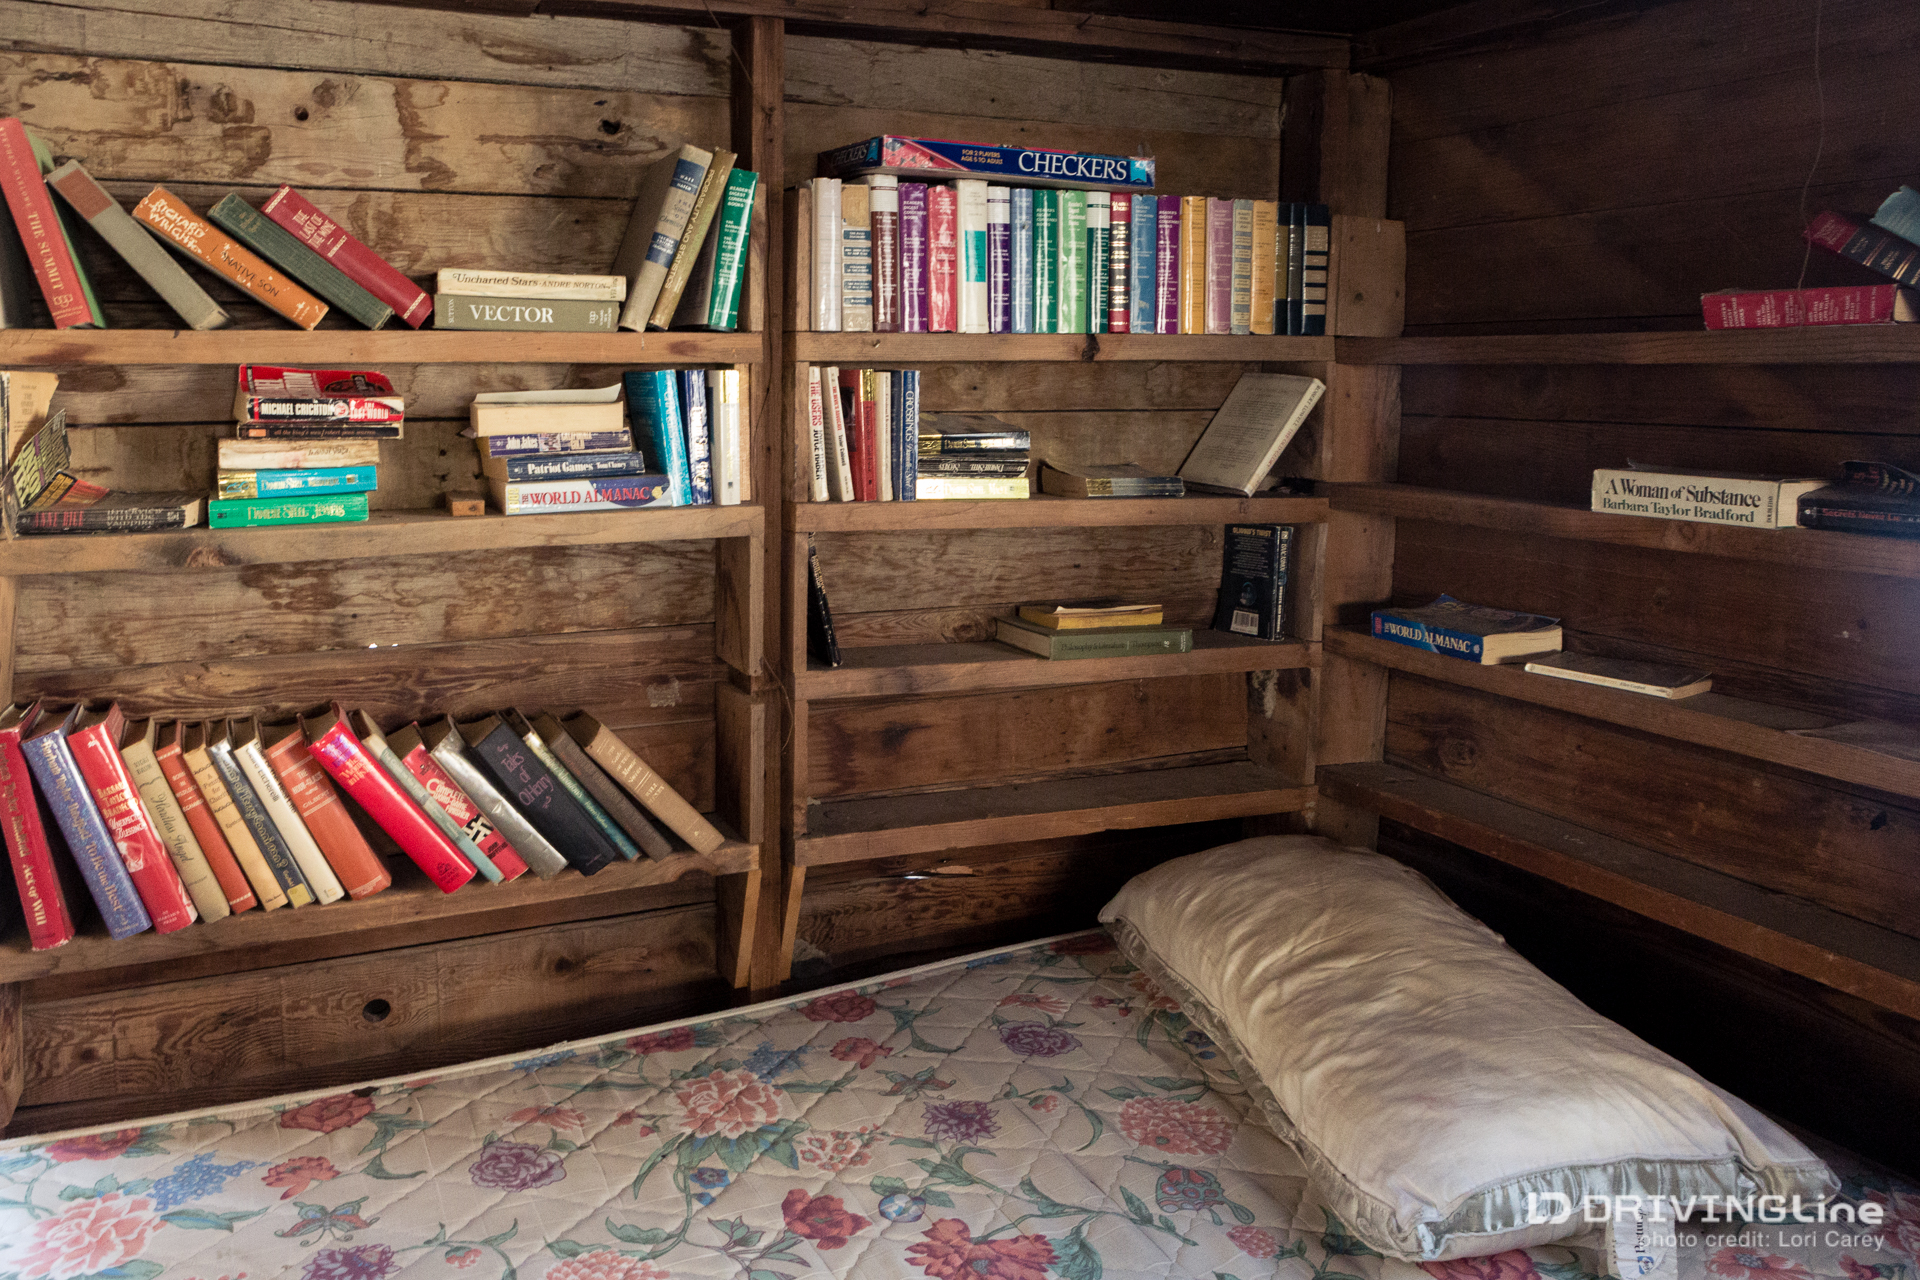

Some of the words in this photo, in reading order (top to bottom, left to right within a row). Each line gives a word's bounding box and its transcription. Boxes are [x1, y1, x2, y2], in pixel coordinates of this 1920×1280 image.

[1018, 152, 1128, 180] CHECKERS
[692, 169, 716, 222] PROBABILITY
[156, 199, 206, 238] RICHARD
[292, 210, 310, 224] THE
[298, 222, 315, 240] LAST
[311, 213, 324, 226] OF
[149, 212, 202, 253] WRIGHT
[307, 231, 325, 250] THE
[319, 218, 337, 237] WINE
[683, 224, 695, 243] AND
[27, 211, 45, 239] THE
[37, 240, 65, 291] SUMMIT
[665, 244, 687, 289] STATISTICS
[257, 280, 280, 297] SON
[452, 273, 509, 286] Uncharted
[511, 277, 538, 287] Stars
[541, 281, 571, 289] ANDRE
[572, 281, 606, 290] NORTON
[469, 304, 554, 323] VECTOR
[810, 380, 821, 397] THE
[261, 403, 294, 415] MICHAEL
[295, 402, 334, 416] CRICHTON
[367, 408, 389, 419] WORLD
[811, 399, 823, 427] USERS
[905, 391, 915, 442] CROSSINGS
[1293, 405, 1309, 427] LOWELL
[506, 438, 521, 450] John
[521, 437, 538, 449] Jakes
[813, 429, 824, 452] JOYCE
[527, 463, 561, 475] Patriot
[562, 462, 593, 473] Games
[596, 462, 607, 470] Tom
[606, 461, 627, 469] Clancy
[815, 454, 825, 480] HABER
[529, 491, 581, 505] WORLD
[585, 487, 650, 503] ALMANAC
[1605, 478, 1618, 495] A
[1620, 478, 1668, 500] Woman
[1671, 487, 1684, 500] of
[1686, 485, 1761, 508] Substance
[33, 511, 58, 527] ANNE
[63, 511, 84, 527] RICE
[107, 508, 163, 516] INTERVIEW
[248, 507, 282, 520] DANIELLE
[282, 506, 310, 519] STEEL
[312, 504, 345, 519] JEWELS
[1602, 498, 1649, 513] Barbara
[1650, 502, 1691, 518] Taylor
[1693, 505, 1755, 523] Bradford
[1389, 622, 1422, 641] WORLD
[1422, 632, 1471, 653] ALMANAC
[136, 761, 152, 775] BAUM
[501, 751, 525, 773] Tales
[518, 765, 532, 783] of
[256, 768, 281, 803] Etcherelli
[425, 778, 466, 801] COMPLETE
[242, 791, 260, 820] Terry
[302, 790, 330, 809] GILBERT
[41, 737, 61, 775] Barbara
[55, 773, 74, 802] Taylor
[68, 801, 92, 840] Bradford
[85, 843, 96, 859] To
[91, 855, 103, 873] Be
[98, 870, 110, 888] the
[105, 884, 123, 912] Best
[150, 792, 176, 834] Headless
[168, 832, 194, 864] Angel
[22, 863, 34, 881] Act
[28, 883, 38, 898] of
[31, 896, 47, 926] Will
